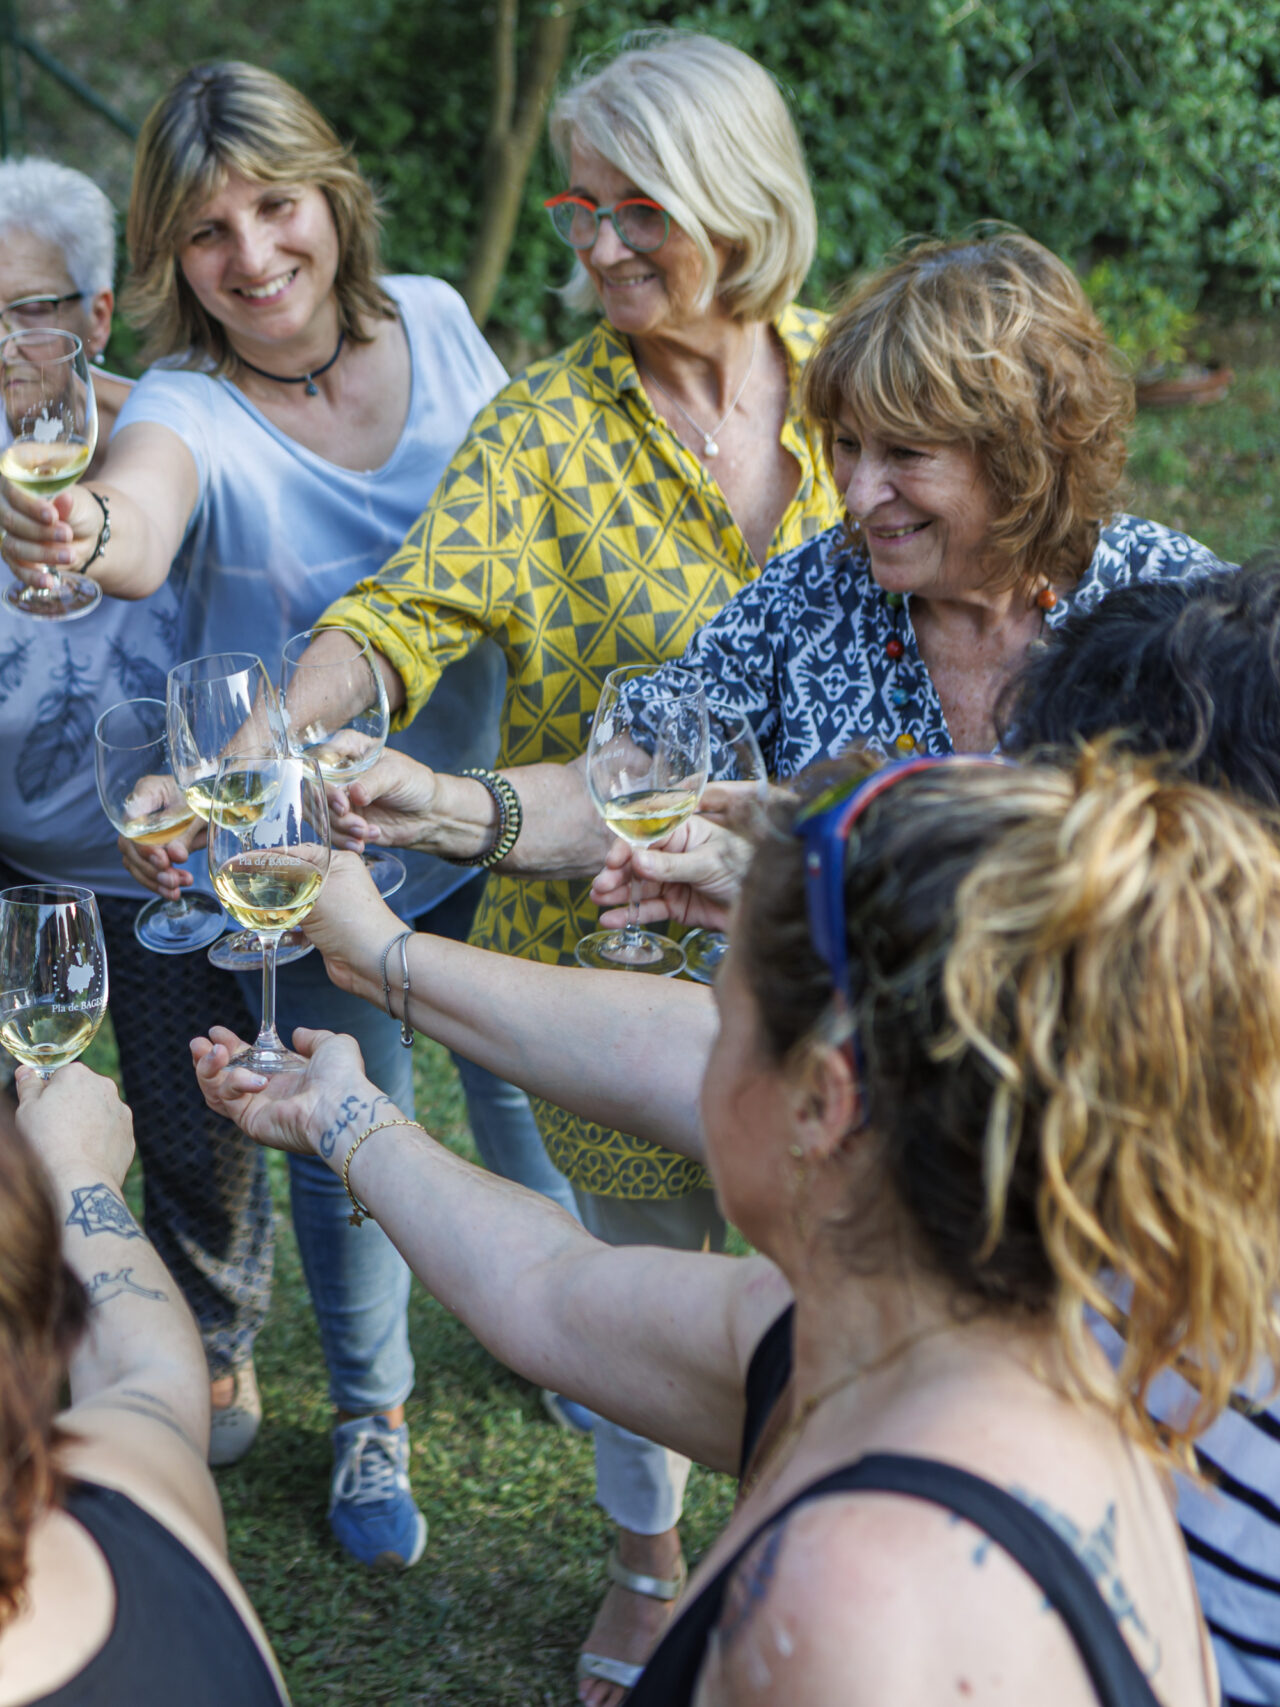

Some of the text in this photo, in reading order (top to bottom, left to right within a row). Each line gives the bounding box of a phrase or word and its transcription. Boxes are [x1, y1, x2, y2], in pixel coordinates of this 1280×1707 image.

[239, 856, 301, 866] Pla de BAGES
[52, 1003, 66, 1013] Pla
[68, 1002, 79, 1012] de
